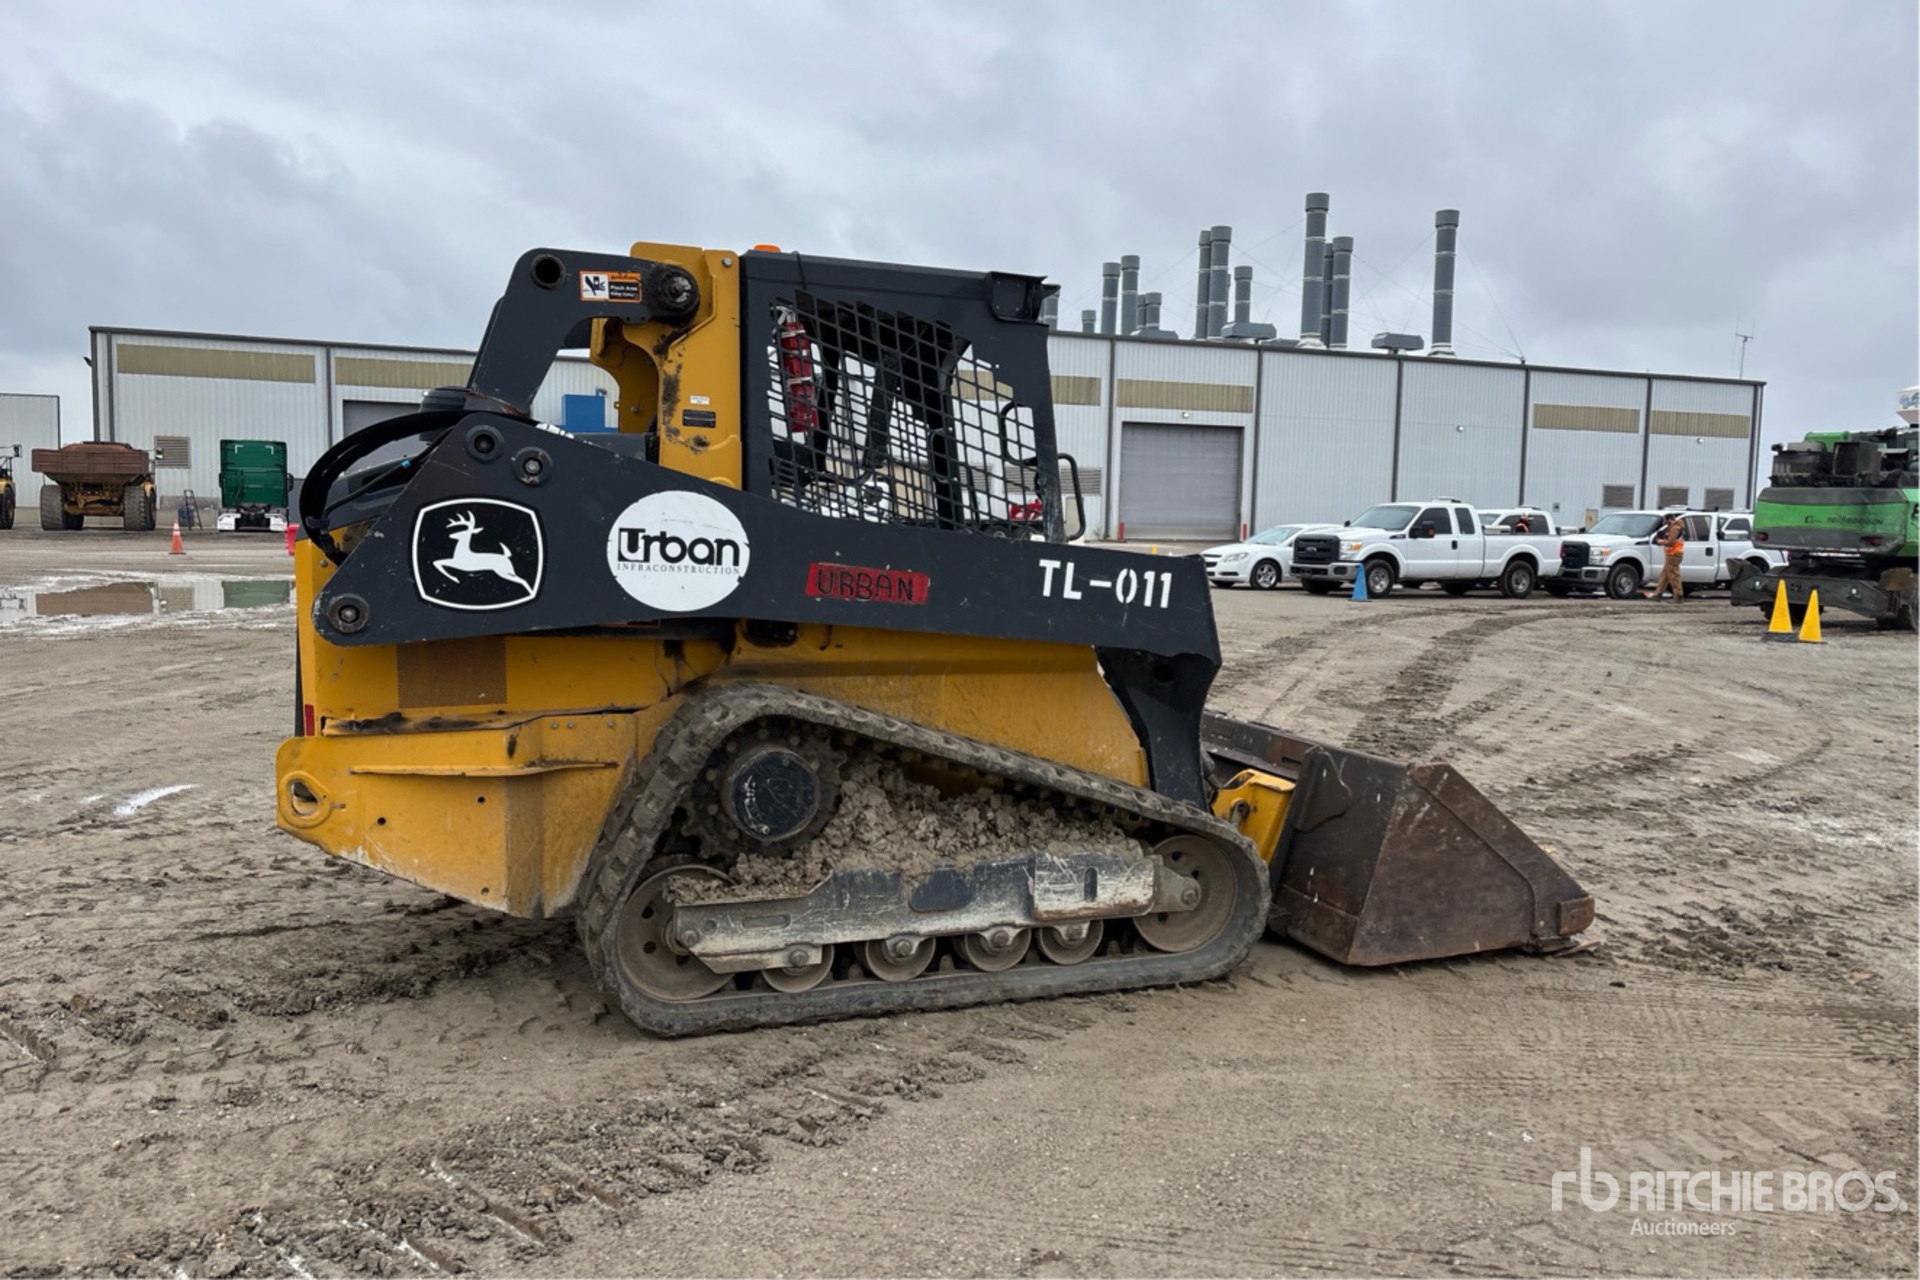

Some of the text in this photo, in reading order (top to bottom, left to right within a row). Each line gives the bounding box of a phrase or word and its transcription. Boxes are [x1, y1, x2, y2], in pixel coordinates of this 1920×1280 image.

[617, 527, 740, 567] Urban
[616, 562, 740, 575] INFRACONSTRUCTION
[817, 568, 913, 601] URBAN
[1039, 558, 1173, 609] TL-011
